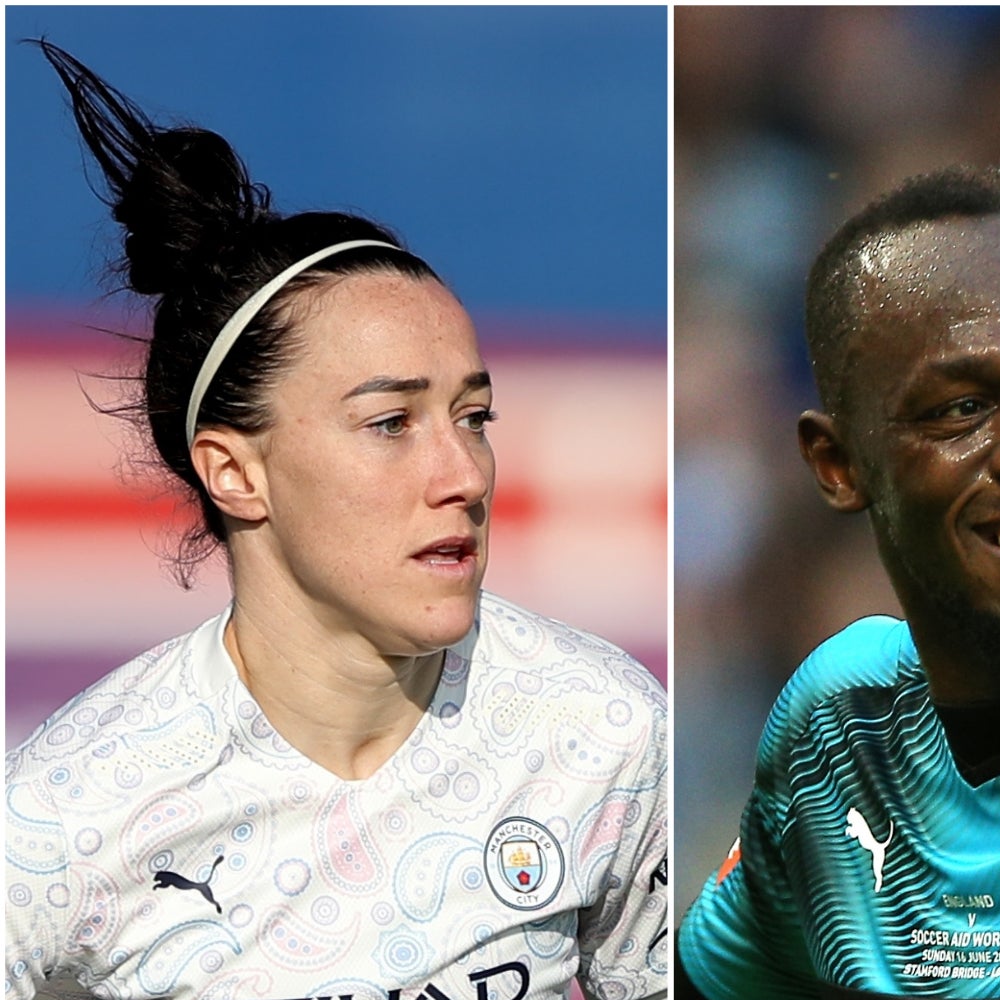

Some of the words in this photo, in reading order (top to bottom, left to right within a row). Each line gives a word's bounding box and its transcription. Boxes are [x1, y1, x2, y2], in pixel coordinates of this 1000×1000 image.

[490, 825, 552, 854] MANCHESTER
[516, 895, 539, 904] CITY
[942, 894, 995, 908] ENGLAND
[910, 929, 950, 945] SOCCER
[951, 931, 971, 947] AID
[922, 949, 956, 962] SUNDAY
[968, 951, 992, 963] JUNE
[903, 963, 951, 978] STAMFORD
[951, 966, 986, 979] BRIDGE
